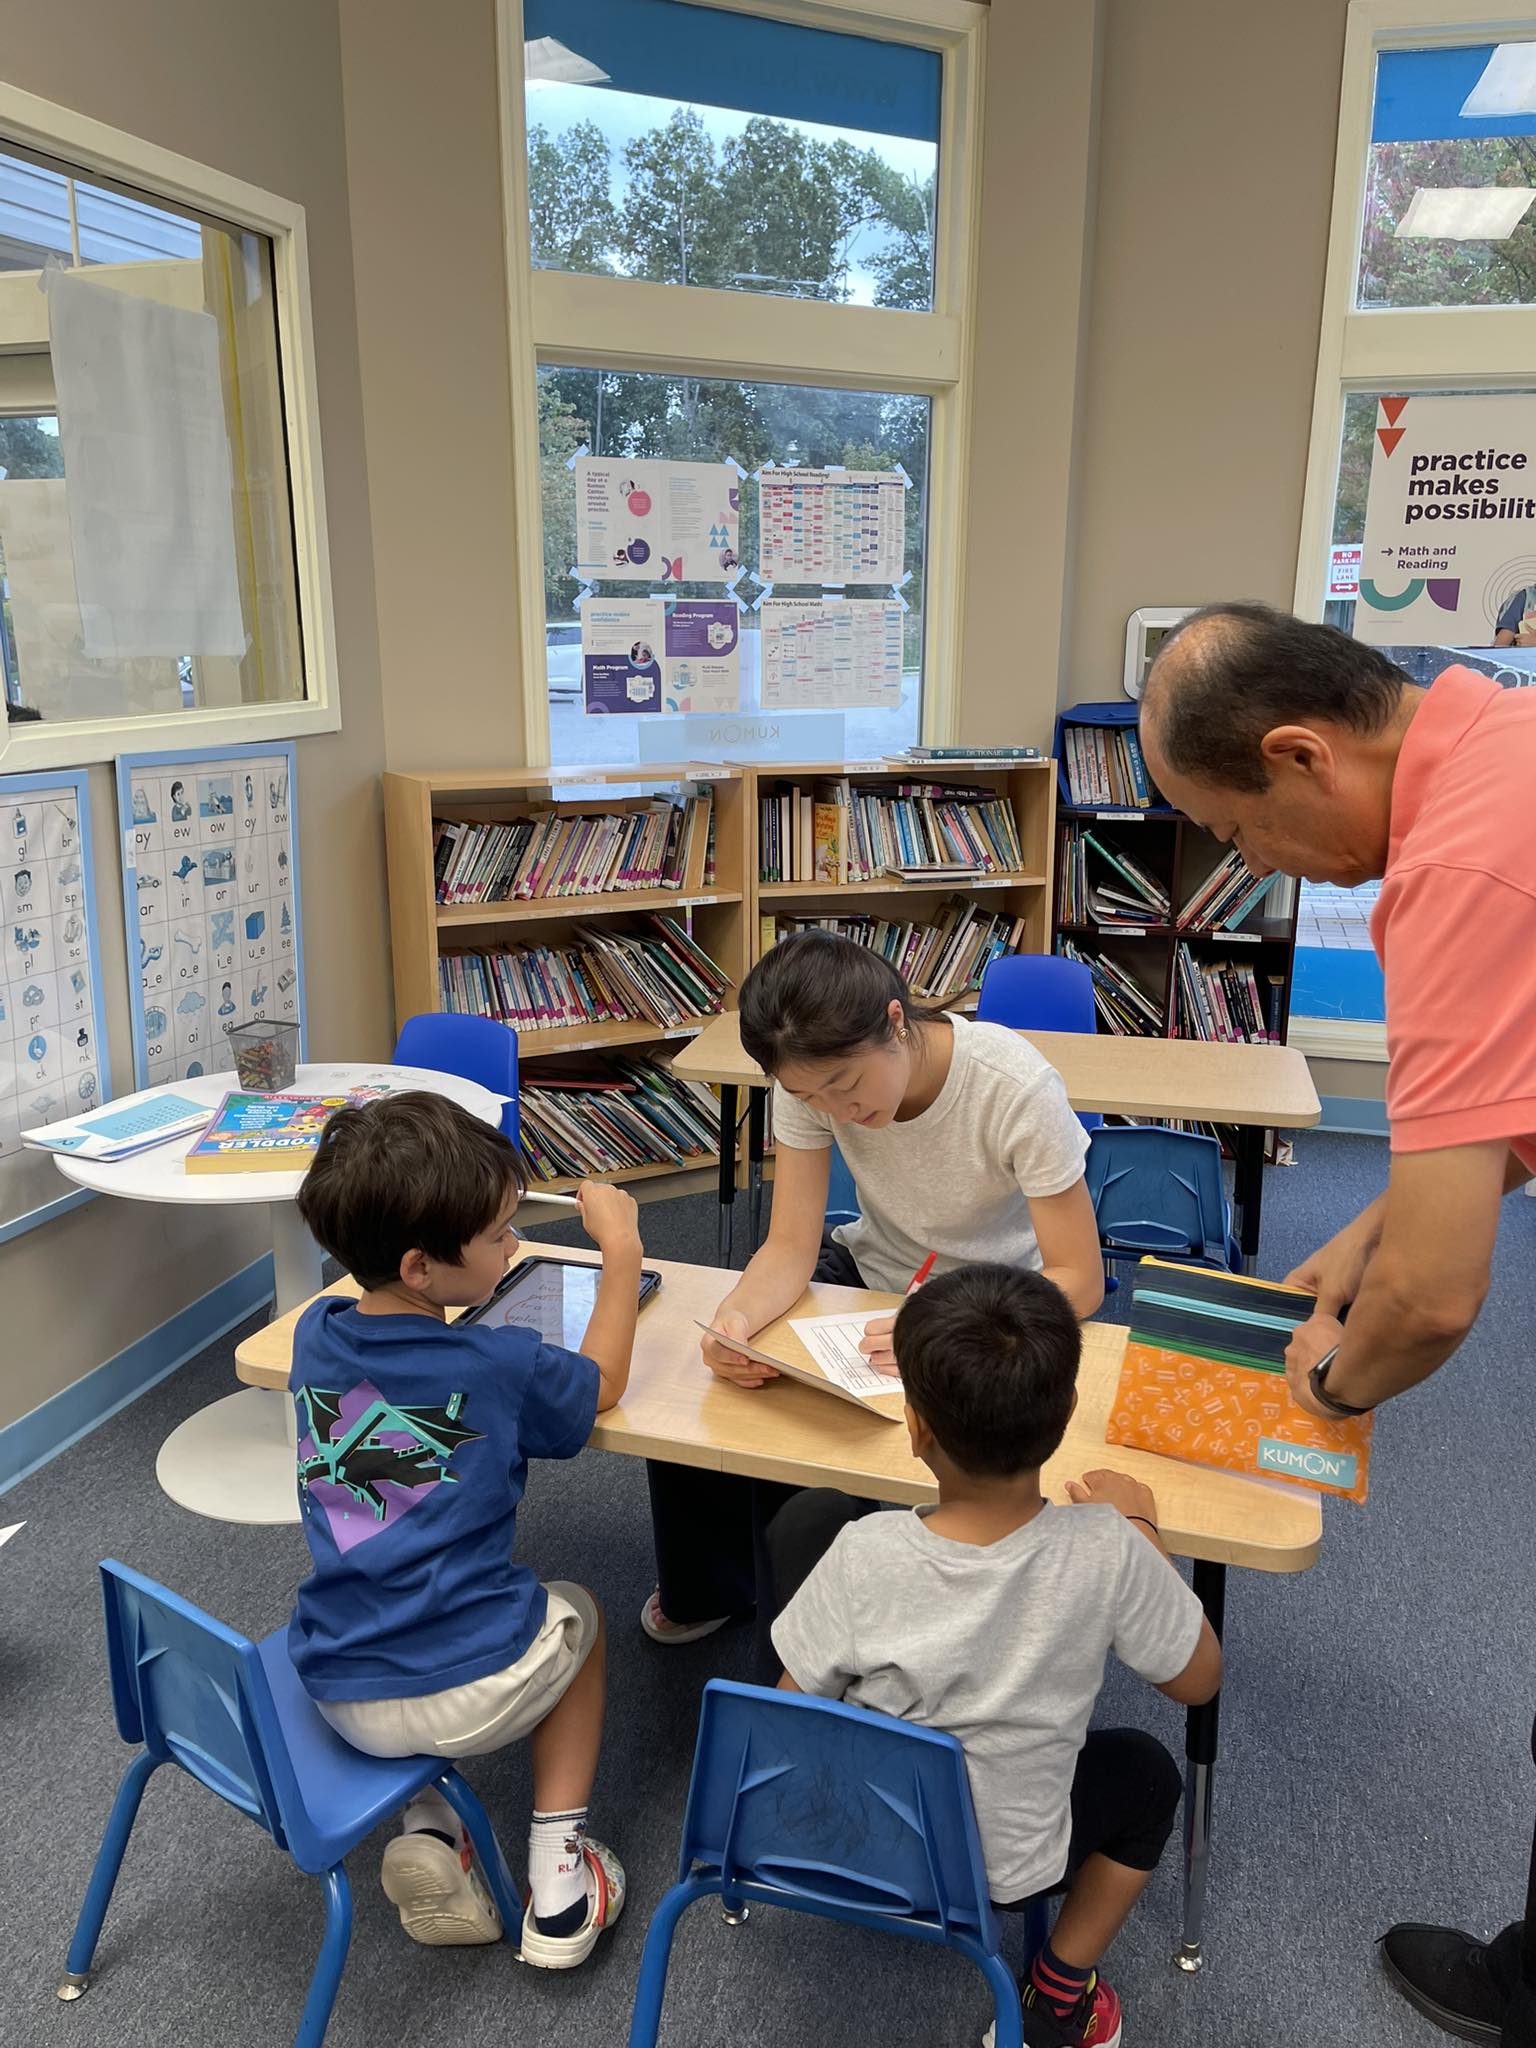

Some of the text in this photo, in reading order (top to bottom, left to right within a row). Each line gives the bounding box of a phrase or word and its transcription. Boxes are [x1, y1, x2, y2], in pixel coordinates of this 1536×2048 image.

[1411, 449, 1527, 476] practice
[1408, 474, 1499, 496] makes
[1399, 545, 1456, 556] Math and
[1397, 559, 1448, 571] Reading
[210, 822, 226, 833] ow
[244, 818, 257, 834] oy
[174, 827, 190, 838] ew
[62, 834, 73, 848] br
[135, 832, 151, 850] ay
[18, 840, 27, 862] gl
[279, 876, 288, 886] er
[248, 882, 259, 893] ur
[182, 892, 190, 908] ir
[216, 889, 227, 900] or
[65, 894, 77, 908] sp
[17, 902, 33, 914] sm
[140, 904, 154, 916] ar
[281, 938, 291, 949] ee
[70, 948, 81, 958] sc
[25, 953, 34, 975] pl
[75, 999, 83, 1010] st
[30, 1015, 40, 1031] pr
[148, 1045, 162, 1056] oo
[36, 1064, 47, 1080] ck
[219, 1136, 317, 1149] TODDLER
[1263, 1447, 1340, 1475] KUMON
[558, 1863, 573, 1874] RL
